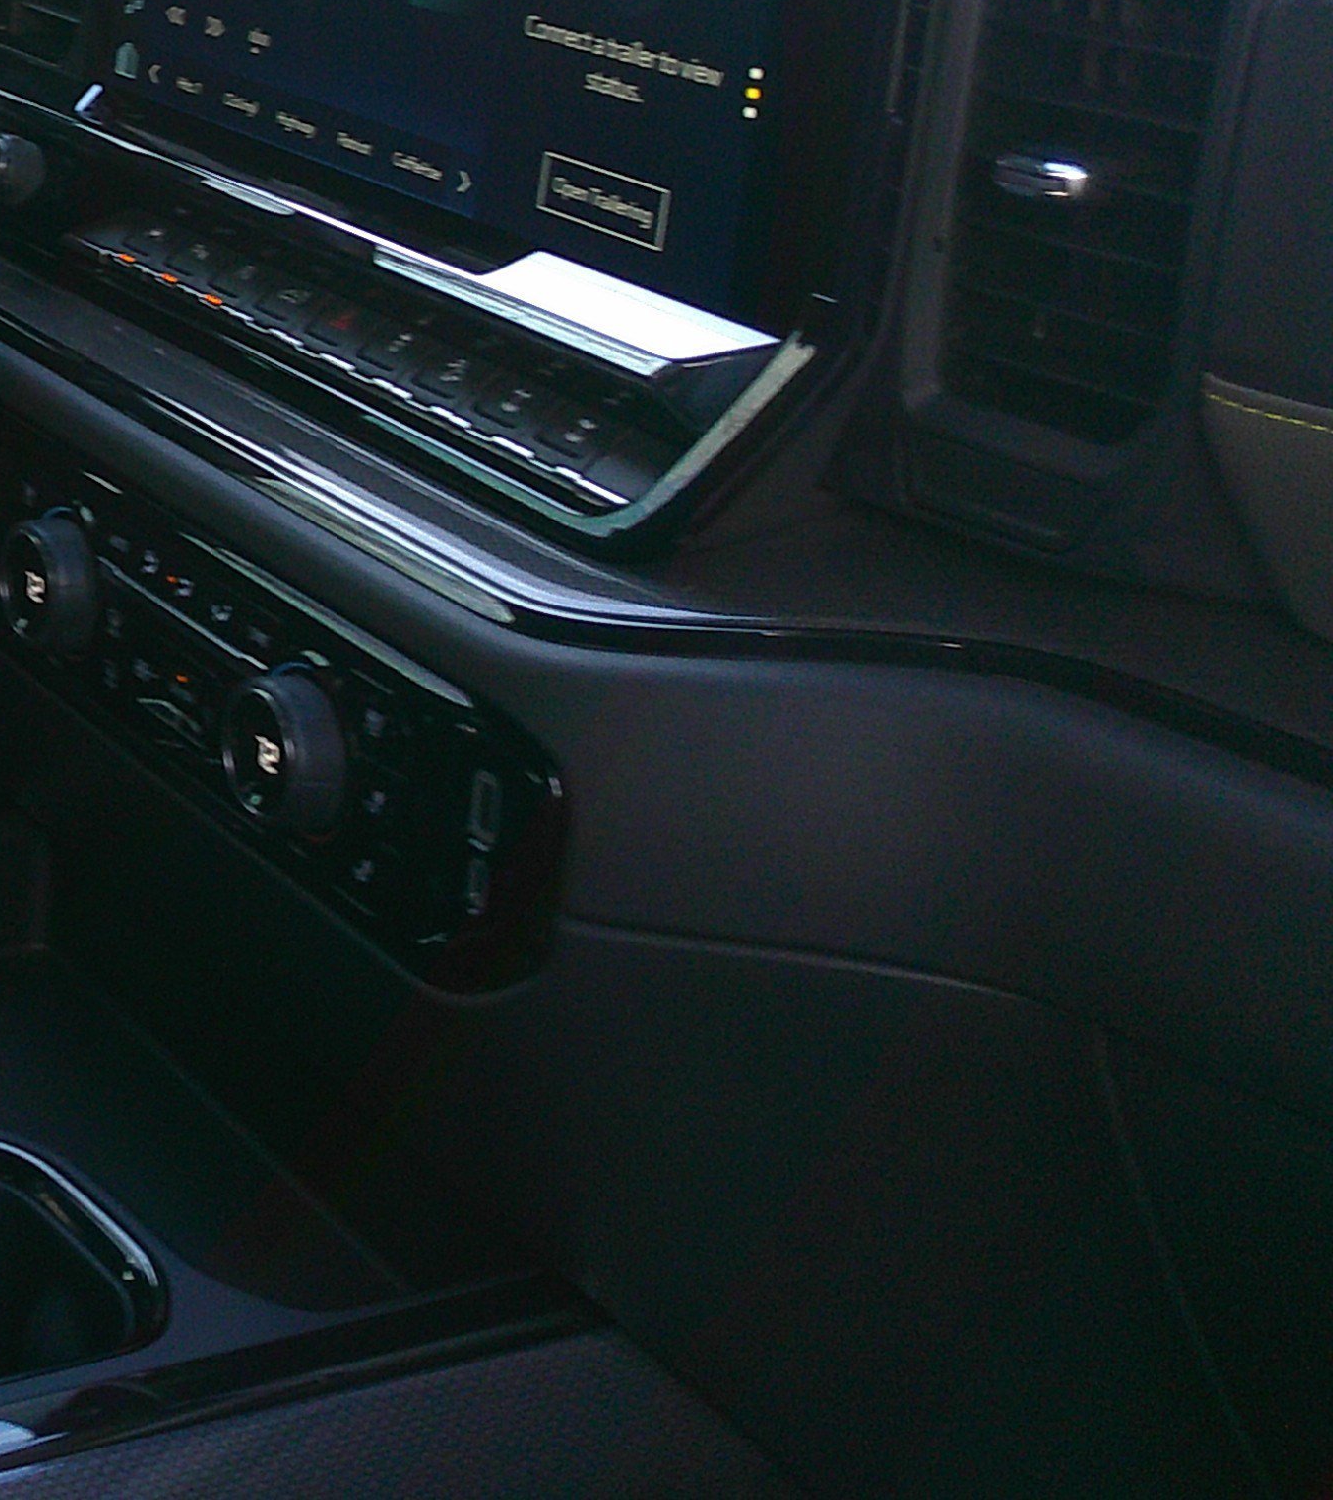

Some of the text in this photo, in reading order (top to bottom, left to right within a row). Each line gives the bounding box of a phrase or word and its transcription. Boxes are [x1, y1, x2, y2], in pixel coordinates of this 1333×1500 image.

[525, 15, 593, 52] Connect
[604, 37, 657, 69] trailer
[658, 51, 680, 76] to
[680, 58, 724, 88] view
[552, 177, 653, 229] Open Trailering
